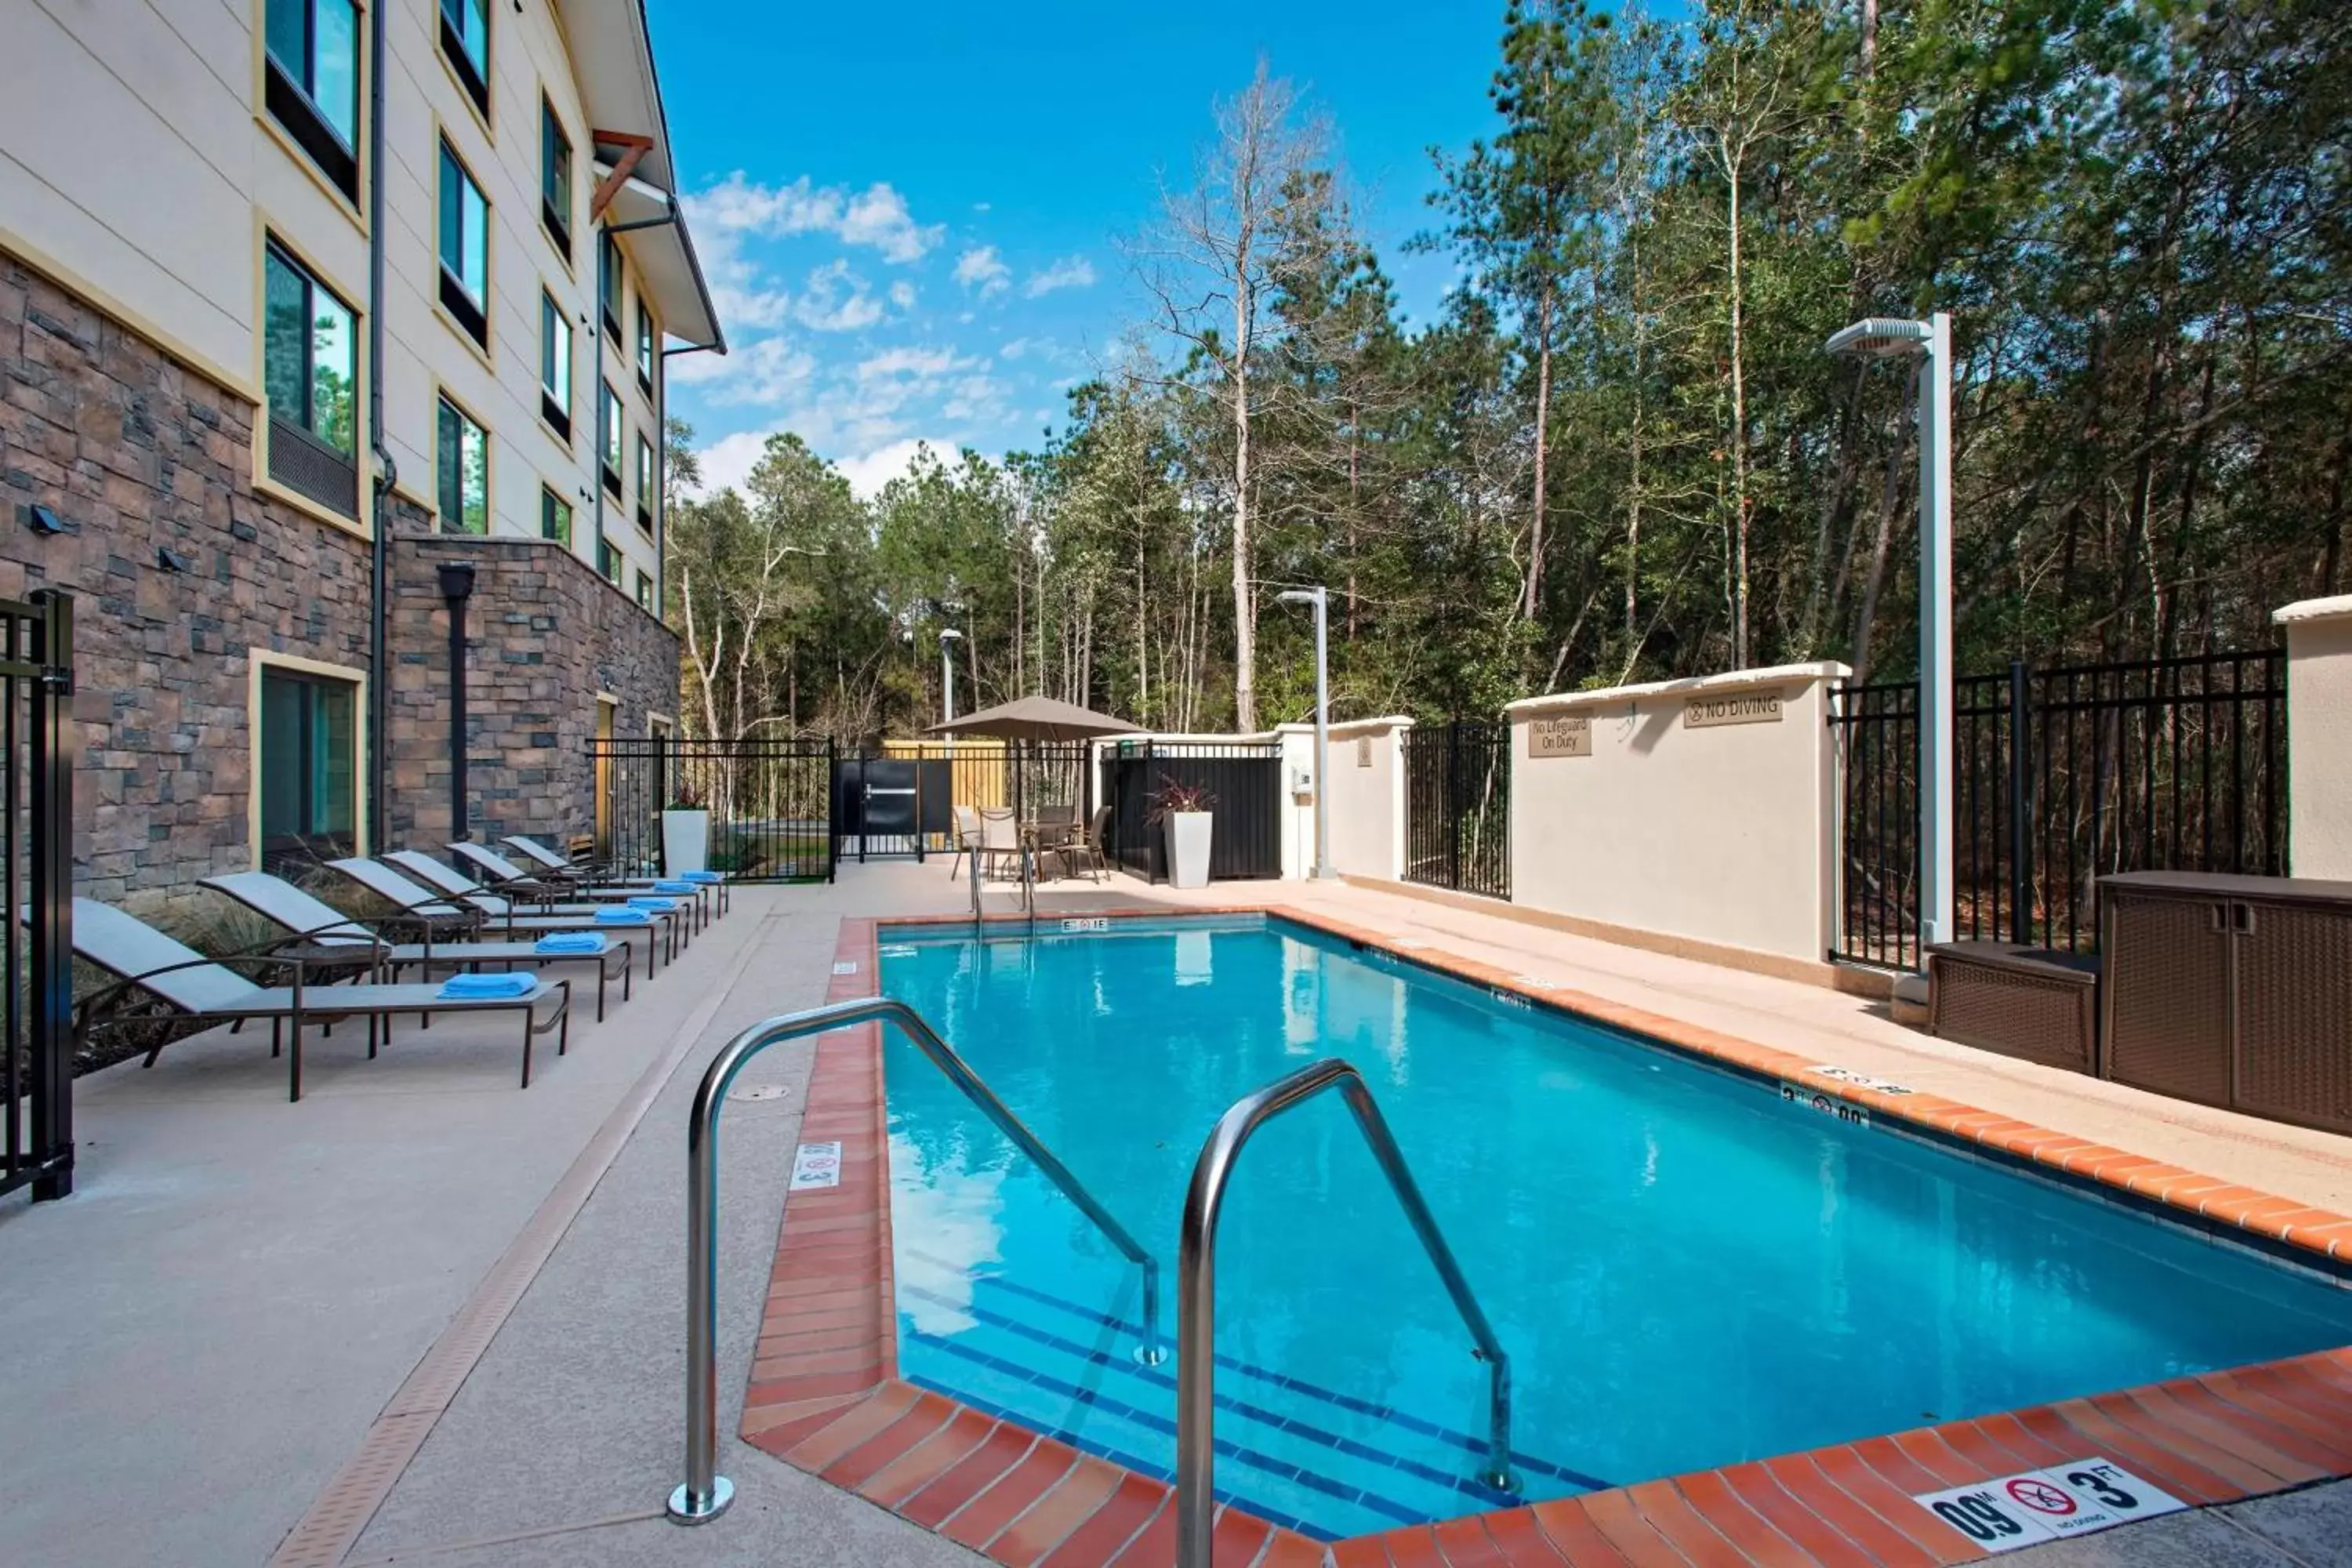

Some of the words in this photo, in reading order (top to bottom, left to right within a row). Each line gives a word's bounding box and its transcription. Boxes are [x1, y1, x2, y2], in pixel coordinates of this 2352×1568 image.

[1706, 702, 1726, 717] NO
[1730, 695, 1777, 716] DIVING
[1533, 721, 1544, 734] No
[1542, 736, 1554, 749] On
[1556, 735, 1578, 750] Duty
[2073, 1513, 2107, 1526] DIVING
